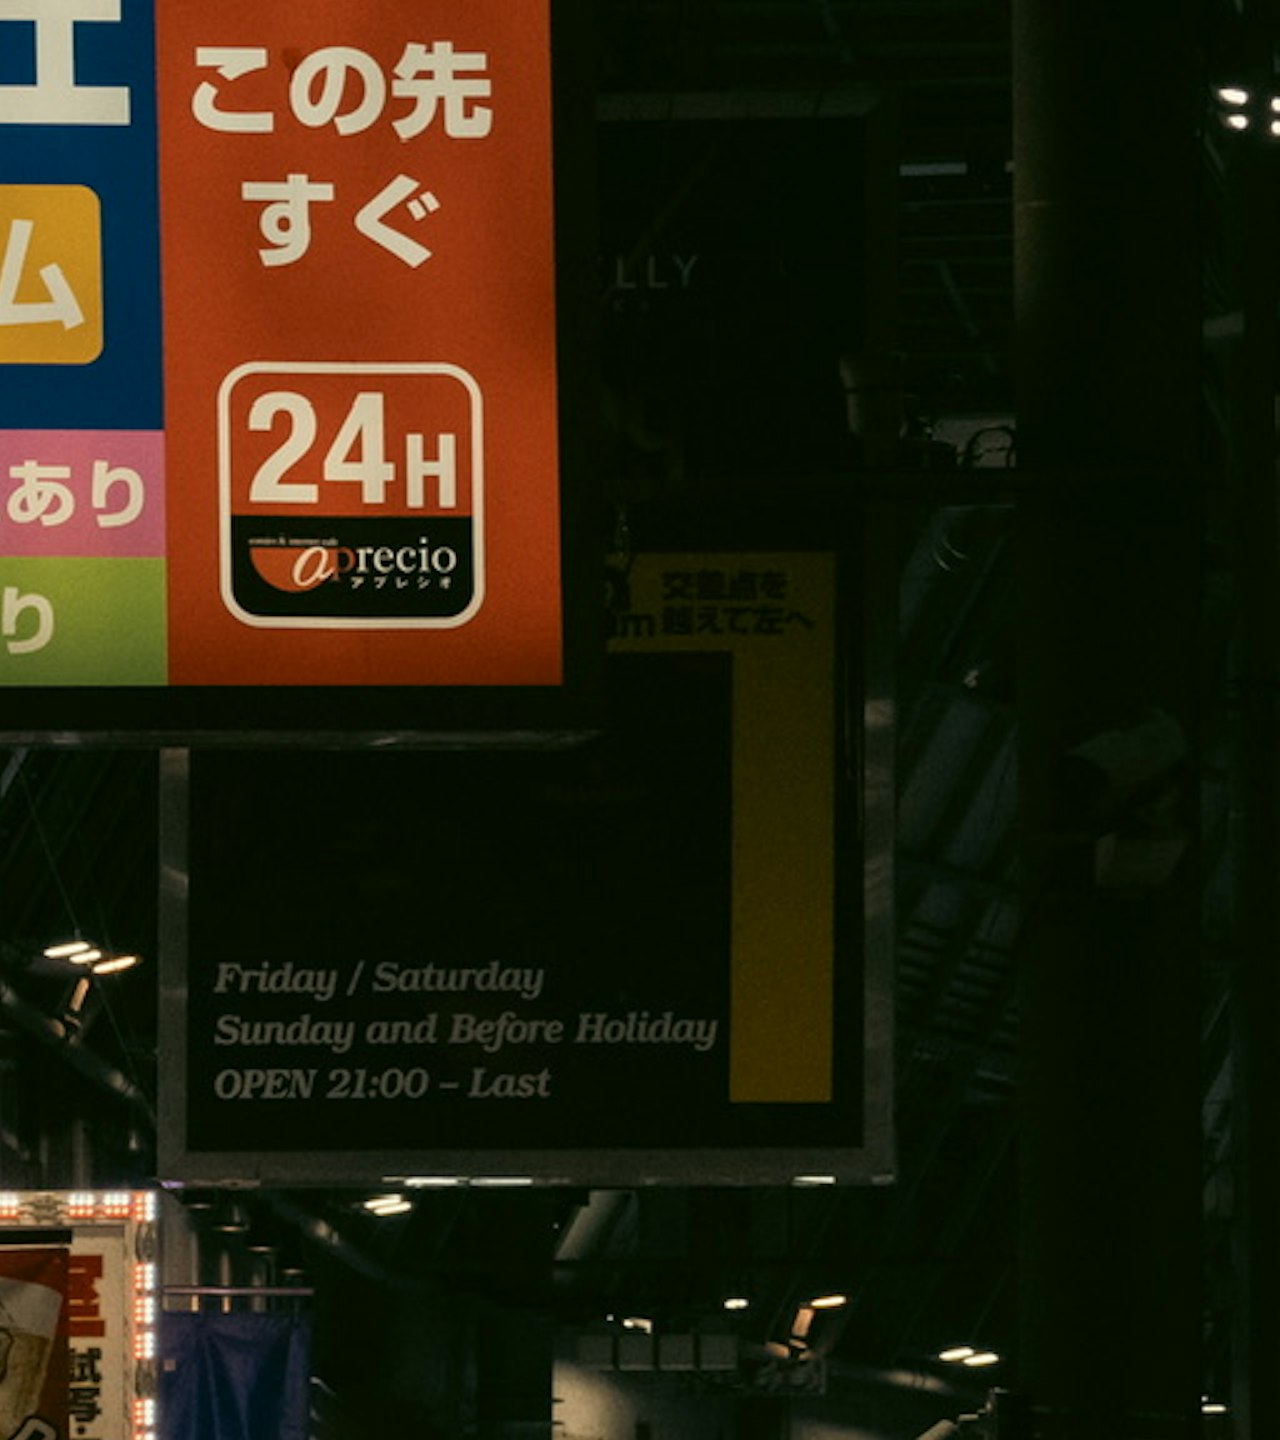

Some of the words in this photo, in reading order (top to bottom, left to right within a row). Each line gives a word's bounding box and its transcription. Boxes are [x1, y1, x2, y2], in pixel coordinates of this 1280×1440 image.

[188, 40, 494, 142] この先
[239, 172, 443, 270] すぐ
[245, 390, 458, 509] 24H
[213, 960, 338, 998] Friday
[371, 960, 546, 999] Saturday
[213, 1011, 355, 1050] Sunday
[364, 1010, 439, 1041] and
[448, 1010, 564, 1051] Before
[573, 1009, 719, 1050] Holiday
[213, 1066, 319, 1101] OPEN
[326, 1066, 430, 1100] 21:00
[467, 1065, 552, 1101] Last
